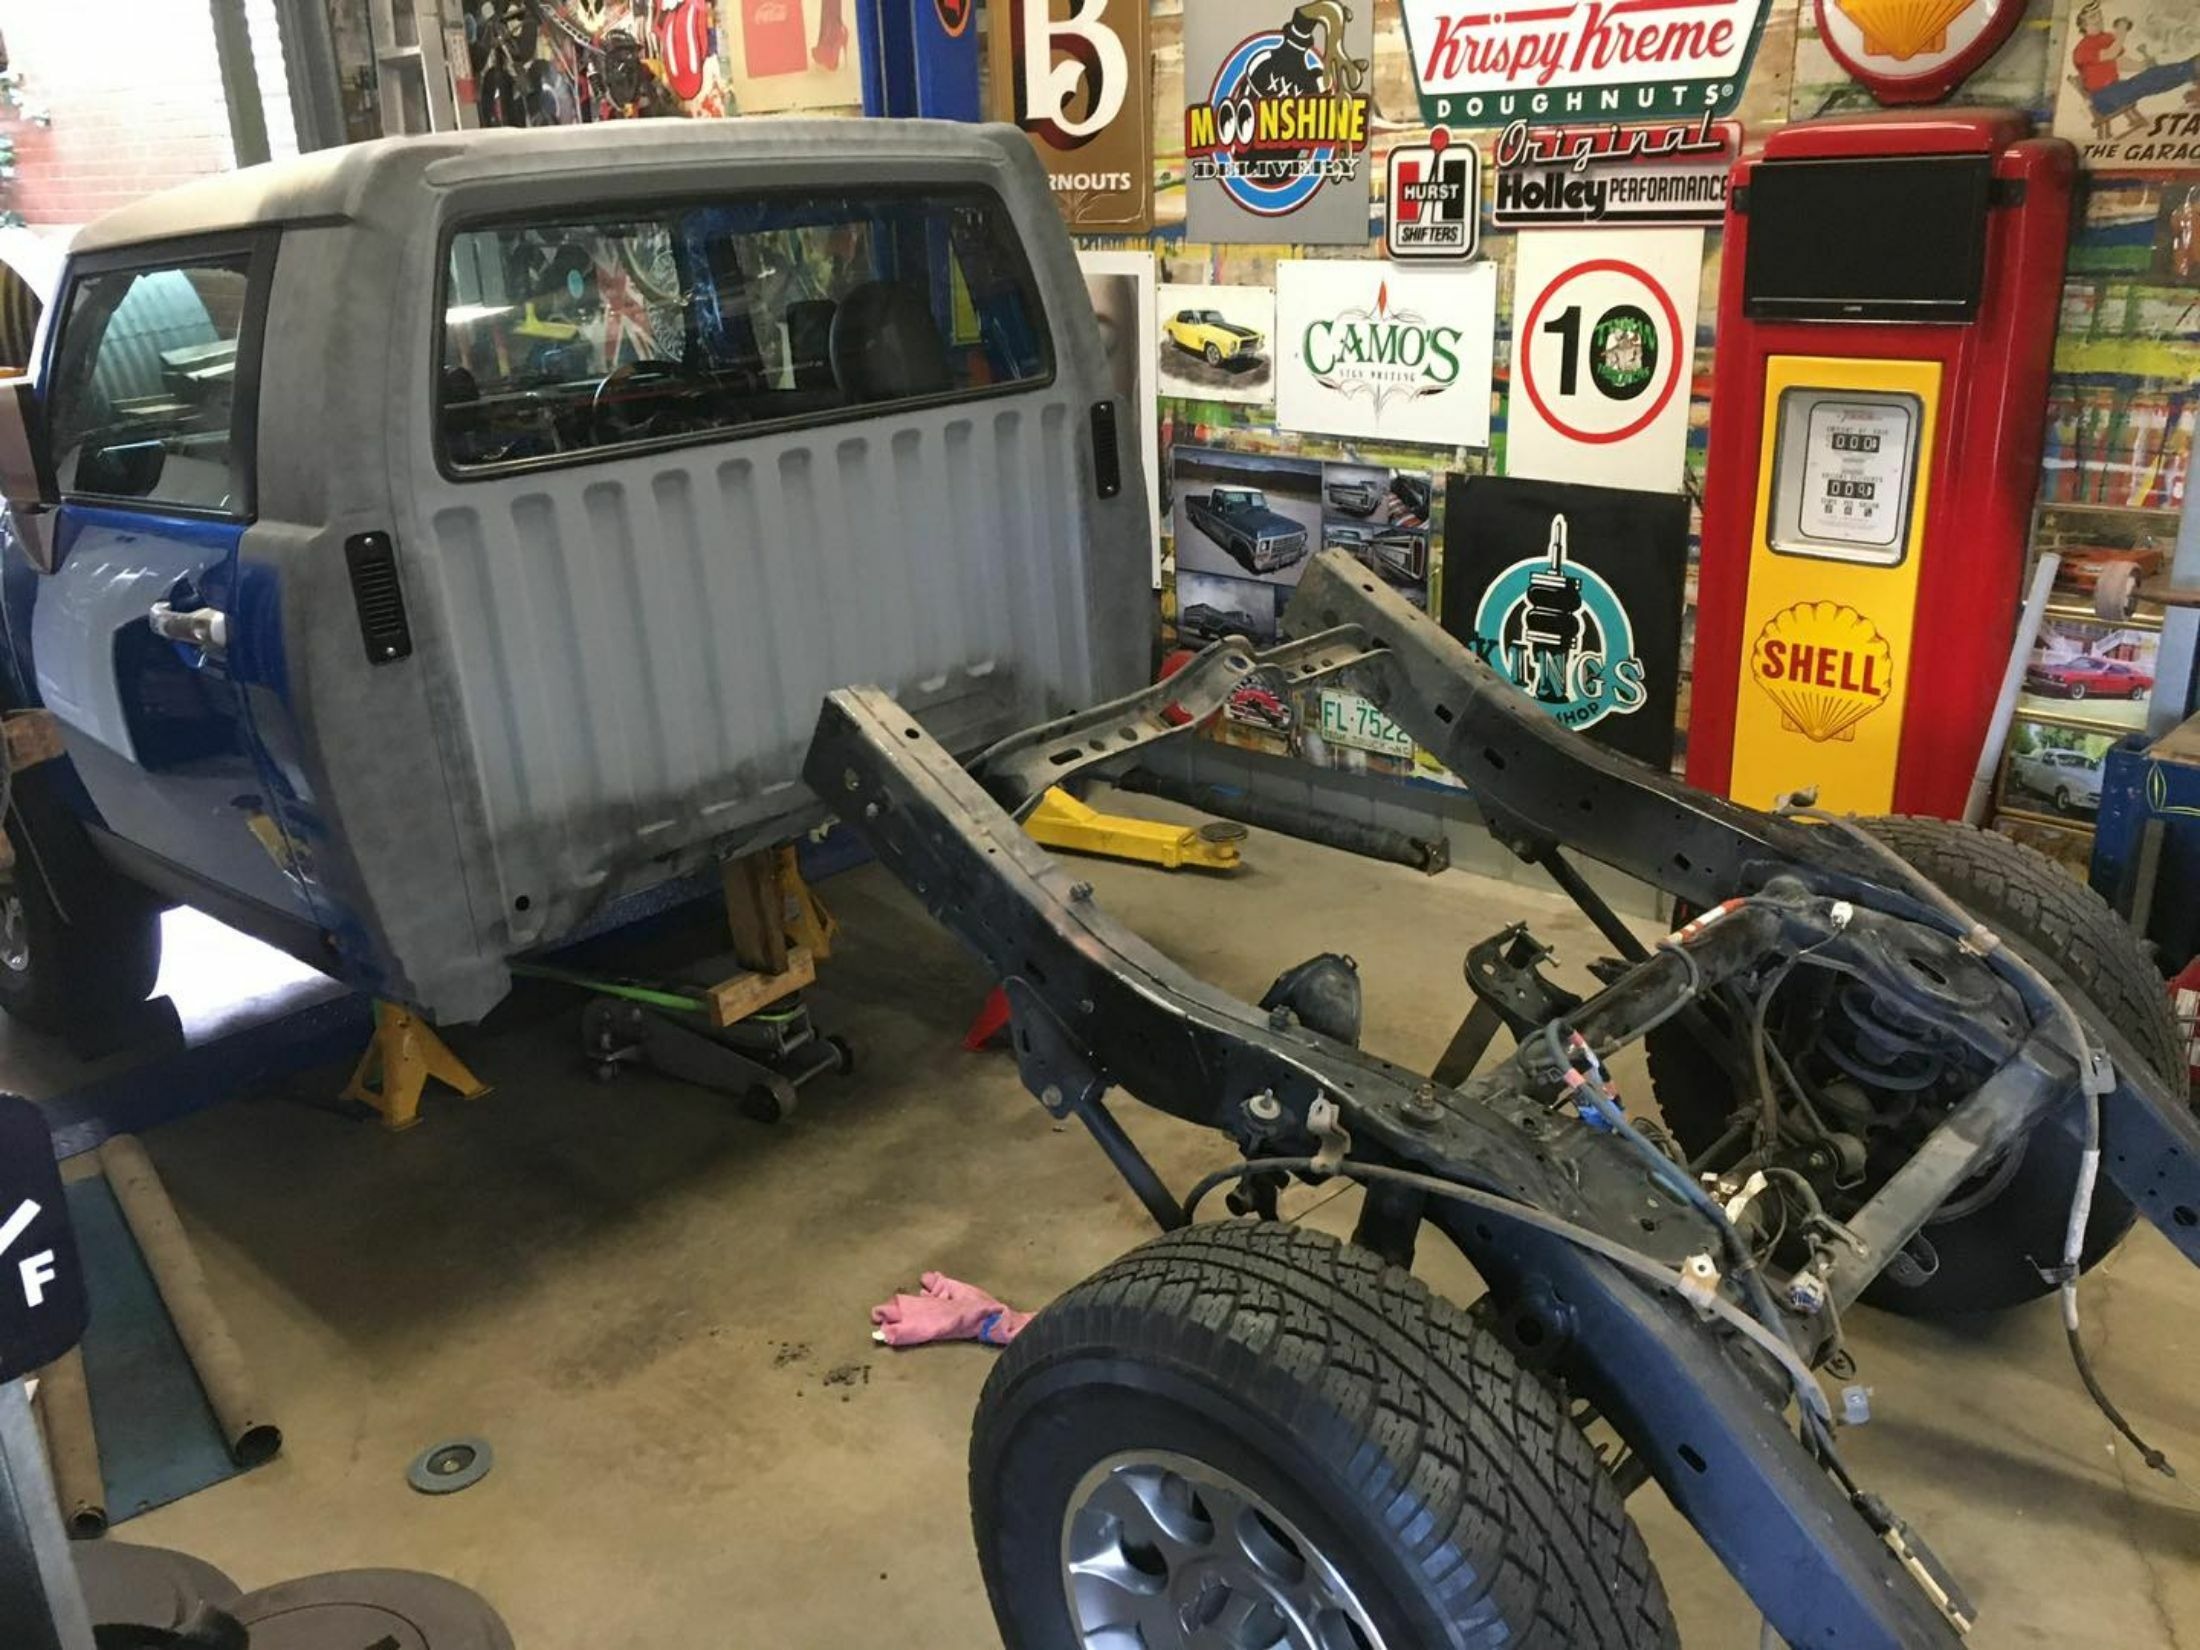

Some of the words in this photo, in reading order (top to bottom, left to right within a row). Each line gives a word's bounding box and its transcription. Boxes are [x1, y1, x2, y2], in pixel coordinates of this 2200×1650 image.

[1423, 3, 1580, 86] Krispy
[1569, 0, 1739, 72] Kreme
[1190, 97, 1366, 148] MOONSHINE
[1436, 84, 1720, 118] DOUGHNUTS
[1496, 110, 1723, 172] Original
[2082, 144, 2120, 158] THE
[1193, 158, 1361, 181] DELIVERY
[1403, 184, 1461, 201] HURST
[1497, 173, 1608, 220] Holley
[1609, 175, 1727, 204] PERFORMANCE
[1401, 225, 1459, 243] SHIFTERS
[1302, 319, 1463, 384] CAMO'S
[1543, 304, 1659, 401] 10
[1761, 638, 1882, 696] SHELL
